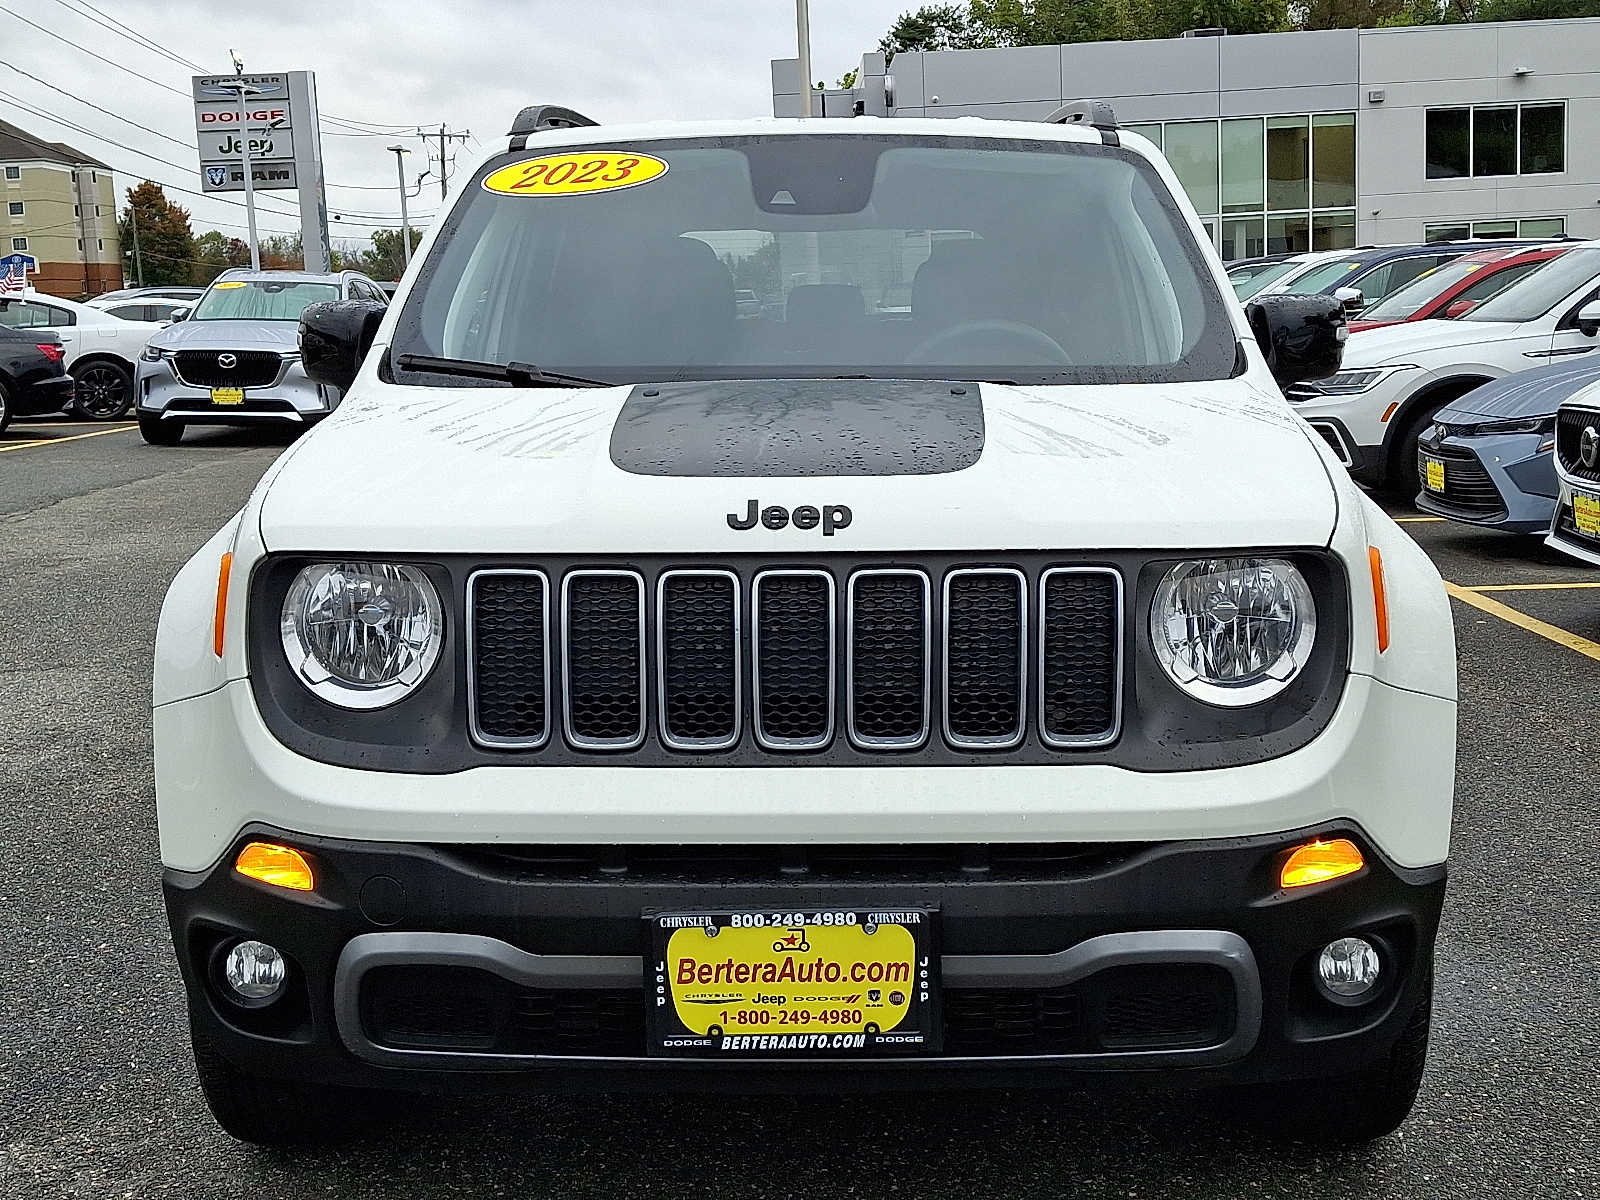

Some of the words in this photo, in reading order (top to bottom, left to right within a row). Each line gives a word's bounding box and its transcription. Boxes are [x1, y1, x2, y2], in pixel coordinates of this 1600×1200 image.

[201, 110, 285, 123] DODGE
[218, 135, 274, 156] Jeep
[230, 170, 290, 181] RAM
[510, 158, 640, 190] 2023
[726, 499, 853, 537] Jeep
[660, 916, 713, 928] CHRYSLER
[731, 912, 857, 928] 800-249-4980
[867, 912, 921, 924] CHRYSLER
[676, 956, 910, 985] BerteraAuto.com
[752, 992, 787, 1006] Jeep
[720, 1010, 863, 1025] 1-800-249-4980
[663, 1039, 713, 1047] DODGE
[721, 1034, 866, 1050] BERTERAAUTO.COM
